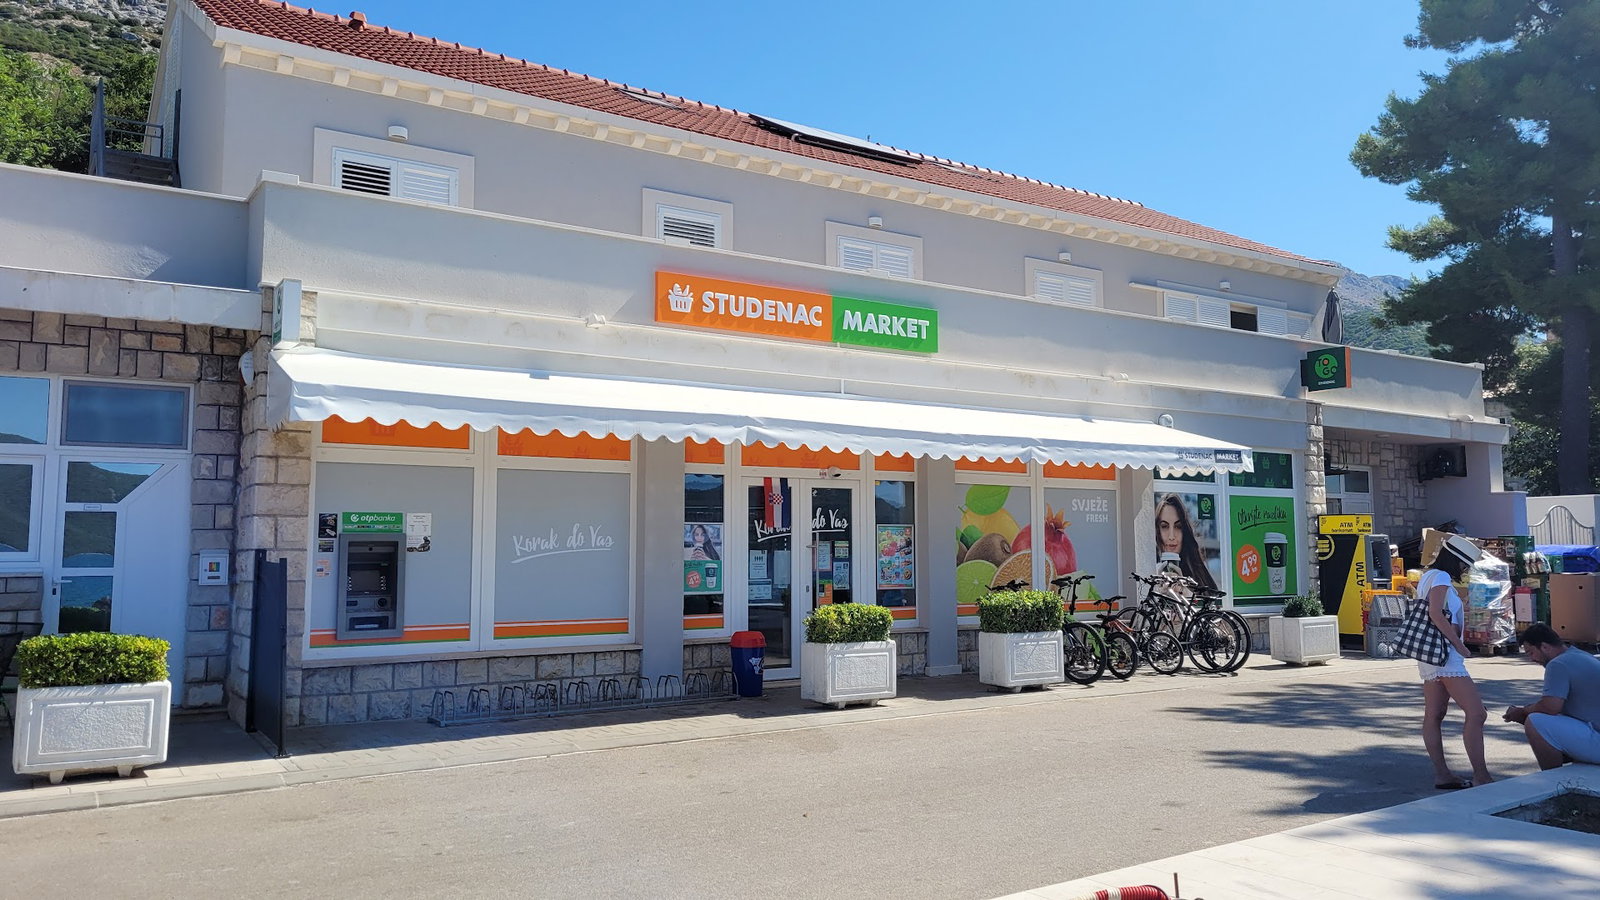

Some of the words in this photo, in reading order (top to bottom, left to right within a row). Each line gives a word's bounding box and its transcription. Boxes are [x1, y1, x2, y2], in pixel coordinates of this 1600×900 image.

[701, 291, 823, 327] STUDENAC
[842, 309, 930, 340] MARKET
[1185, 452, 1213, 460] STUDENAC
[1216, 453, 1239, 461] MARKET
[1071, 496, 1109, 512] SVJEŽE
[360, 514, 396, 523] otpbanka
[812, 507, 826, 529] do
[828, 508, 849, 529] Vas
[1086, 514, 1109, 523] FRESH
[512, 527, 560, 556] Korak
[566, 523, 585, 550] do
[589, 525, 615, 548] Vas
[1355, 561, 1365, 587] ATM
